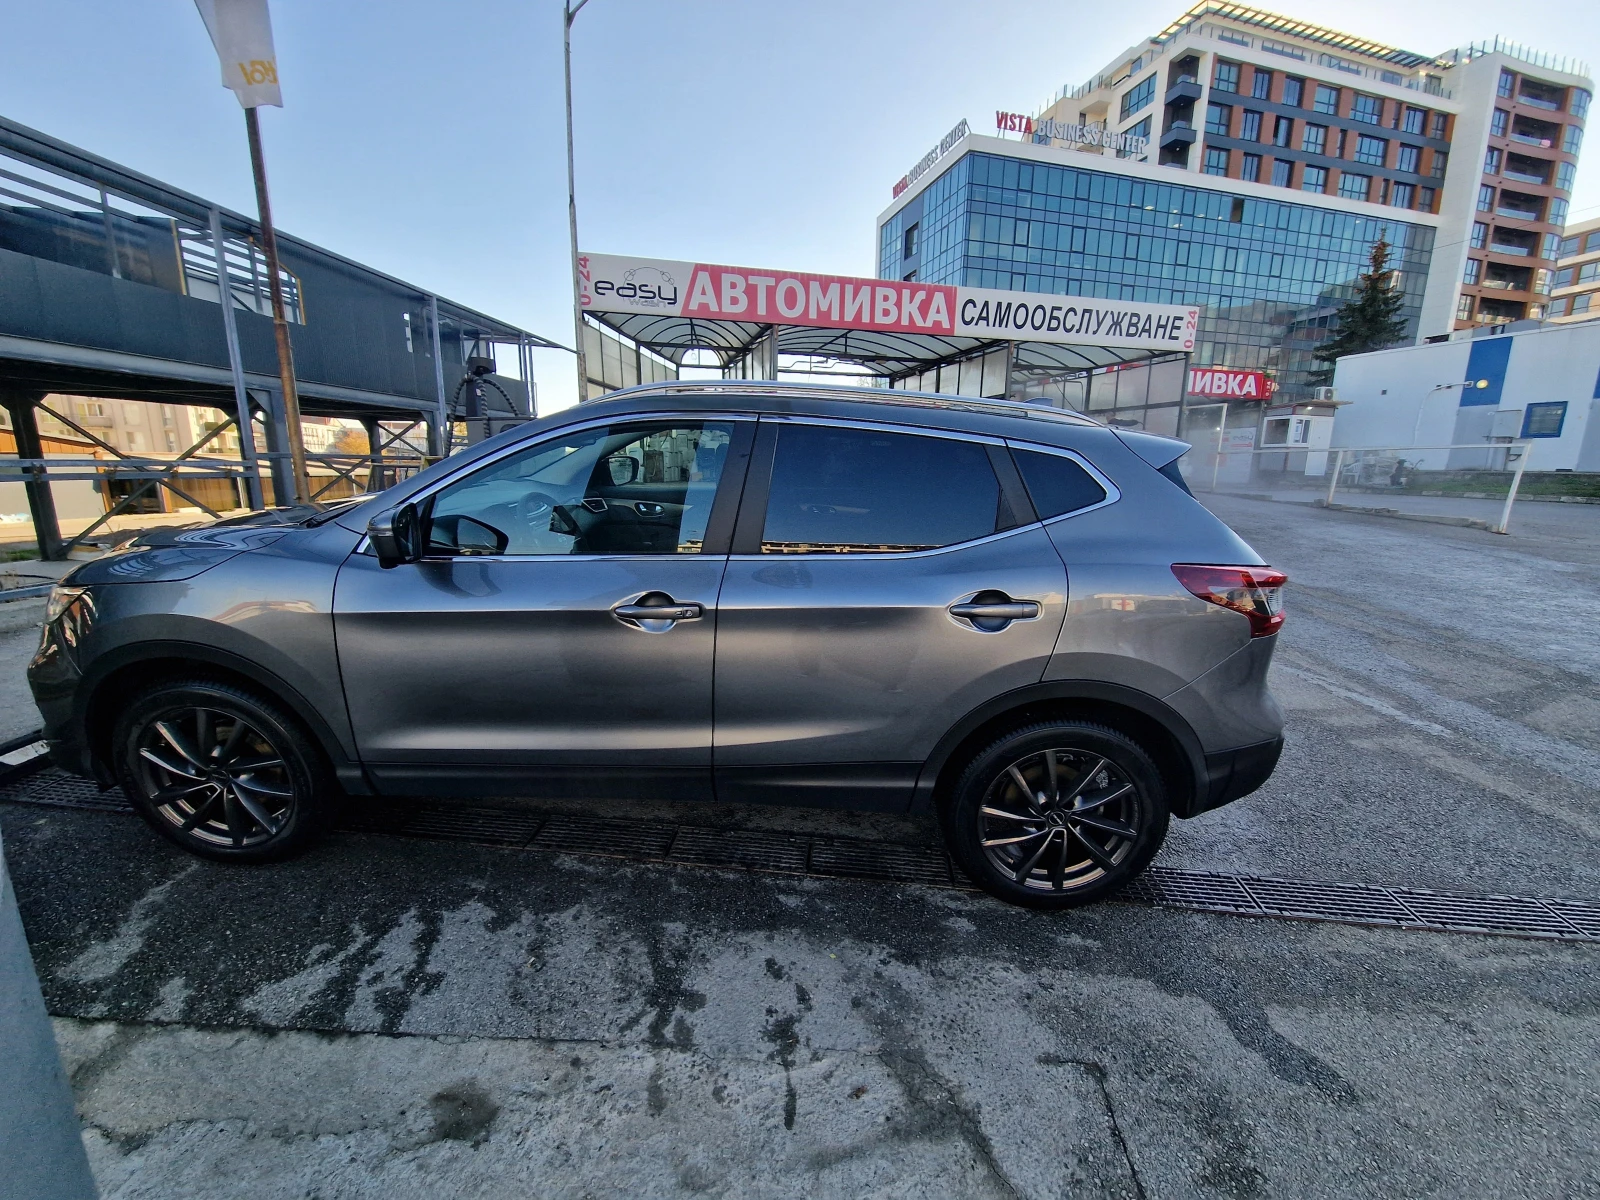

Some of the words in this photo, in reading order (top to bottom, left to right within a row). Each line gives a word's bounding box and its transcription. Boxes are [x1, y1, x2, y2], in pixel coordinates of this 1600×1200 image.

[995, 110, 1033, 134] VISTA
[1037, 118, 1100, 146] BUSINESS
[1102, 129, 1147, 154] CENTER
[594, 280, 678, 305] easy
[688, 270, 951, 330] АВТОМИВКА
[960, 297, 1184, 341] САМООБСЛУЖВАНЕ
